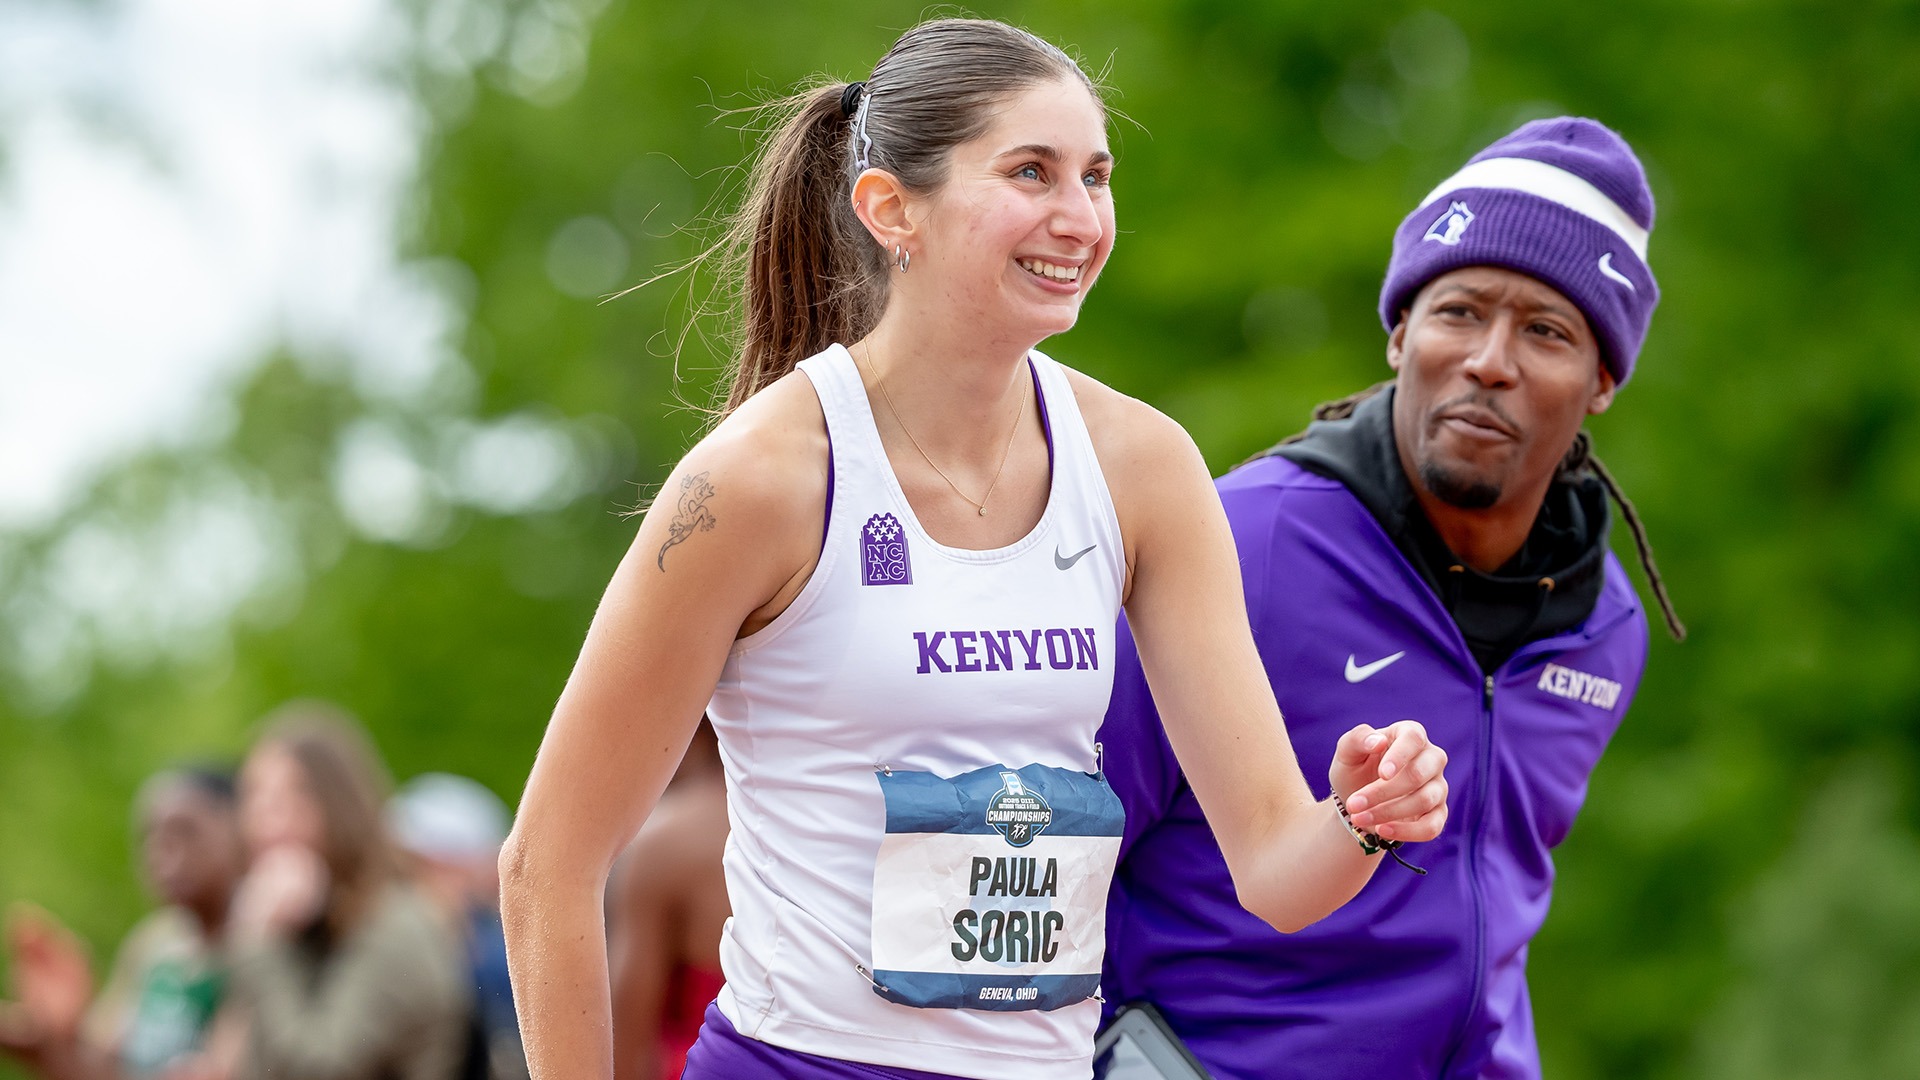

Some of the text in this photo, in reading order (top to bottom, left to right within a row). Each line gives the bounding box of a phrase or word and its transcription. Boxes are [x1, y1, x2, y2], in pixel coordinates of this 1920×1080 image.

[867, 543, 904, 562] NC
[869, 562, 906, 581] AC
[913, 628, 1099, 674] KENYON
[1537, 662, 1622, 711] KENYON
[988, 810, 1051, 822] CHAMPIONSHIPS
[969, 856, 1058, 897] PAULA
[950, 908, 1064, 963] SORIC
[979, 987, 1038, 1001] GENEVA, OHIO
